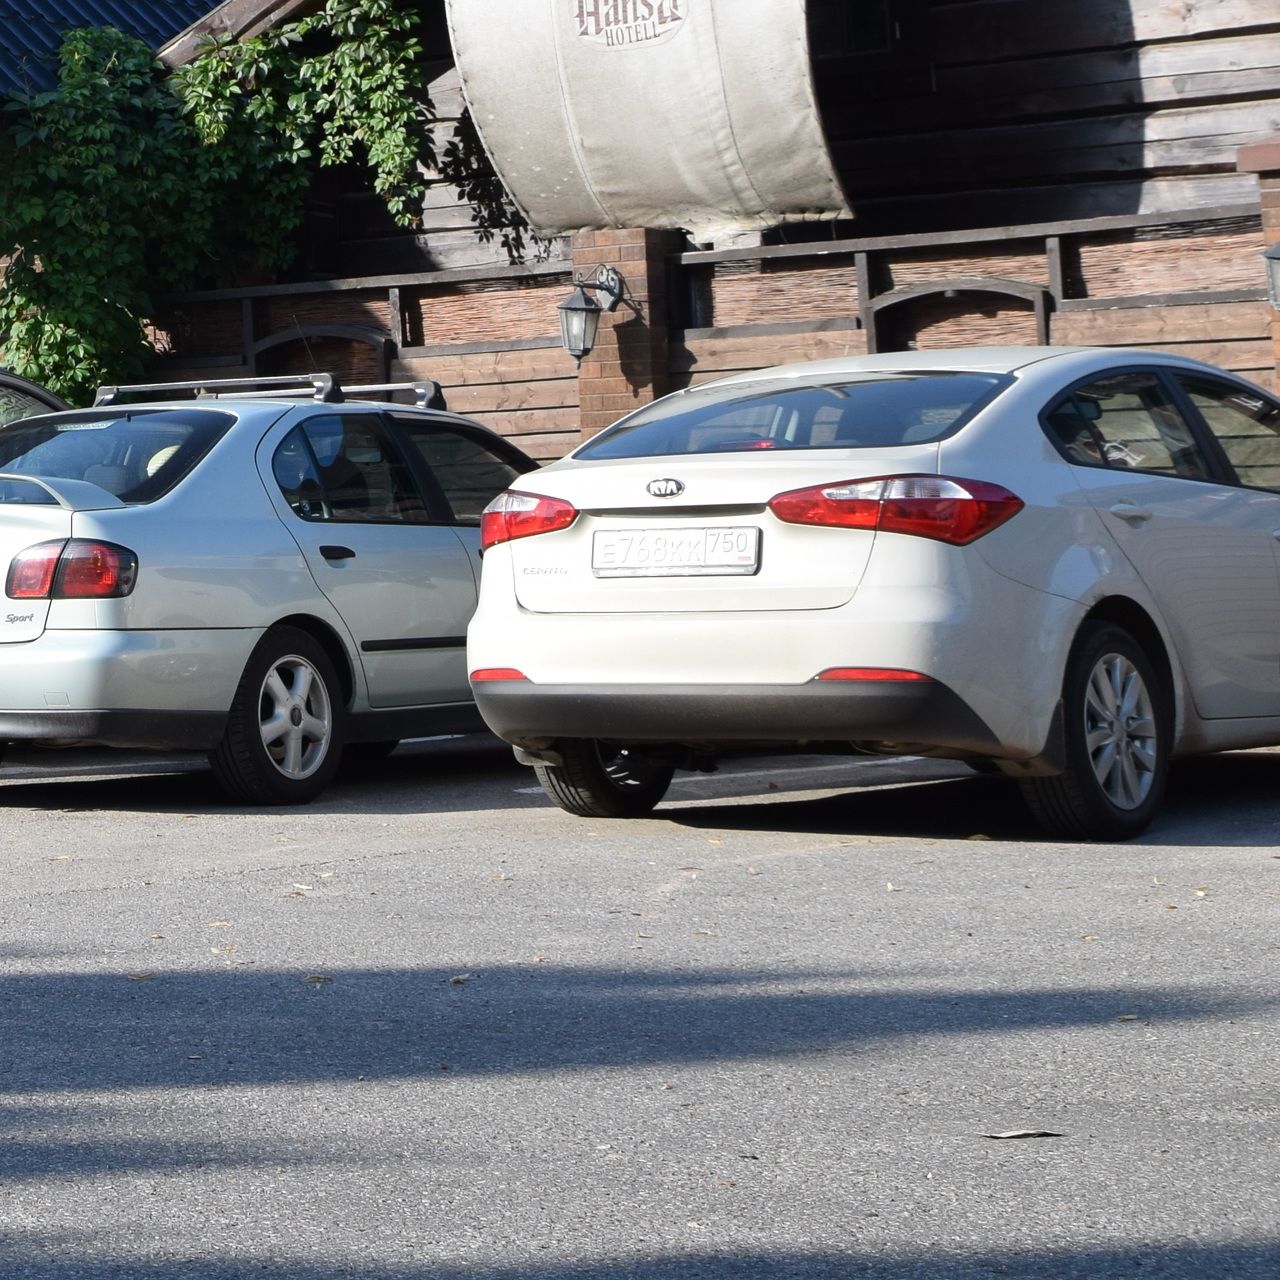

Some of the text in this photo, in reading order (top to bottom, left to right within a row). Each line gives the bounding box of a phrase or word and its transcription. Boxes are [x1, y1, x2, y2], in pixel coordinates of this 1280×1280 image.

[605, 21, 661, 47] HOTELL
[649, 479, 677, 495] KIA
[709, 531, 748, 553] 750
[5, 613, 34, 624] Sport
